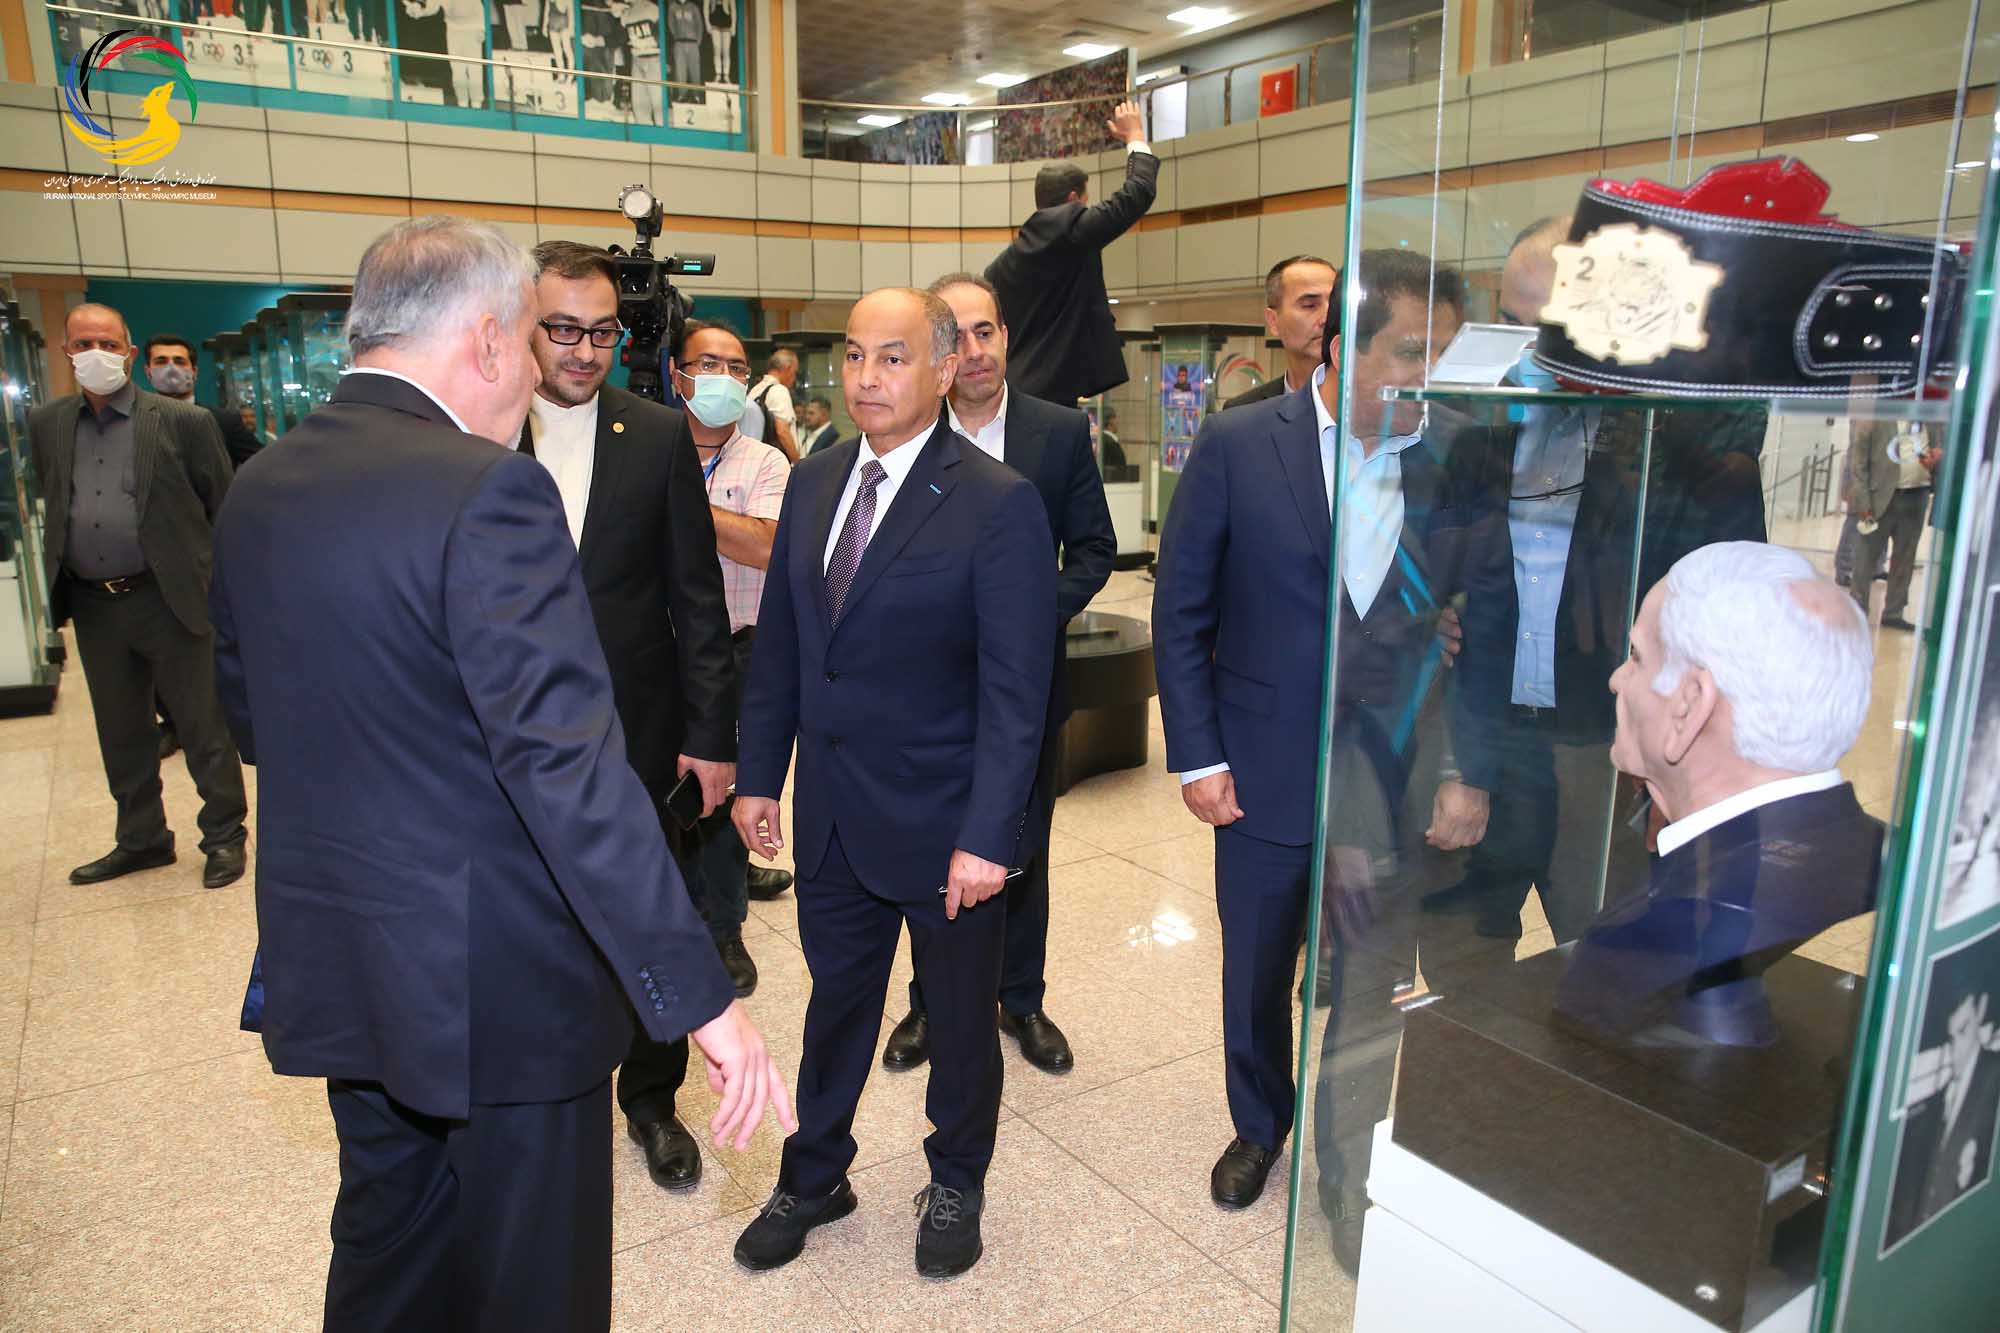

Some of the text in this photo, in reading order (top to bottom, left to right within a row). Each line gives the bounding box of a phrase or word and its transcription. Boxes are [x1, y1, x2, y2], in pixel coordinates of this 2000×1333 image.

[187, 41, 245, 65] 2 3
[298, 47, 353, 73] 2 3
[554, 91, 567, 111] 3
[687, 109, 695, 125] 2
[1576, 256, 1595, 281] 2
